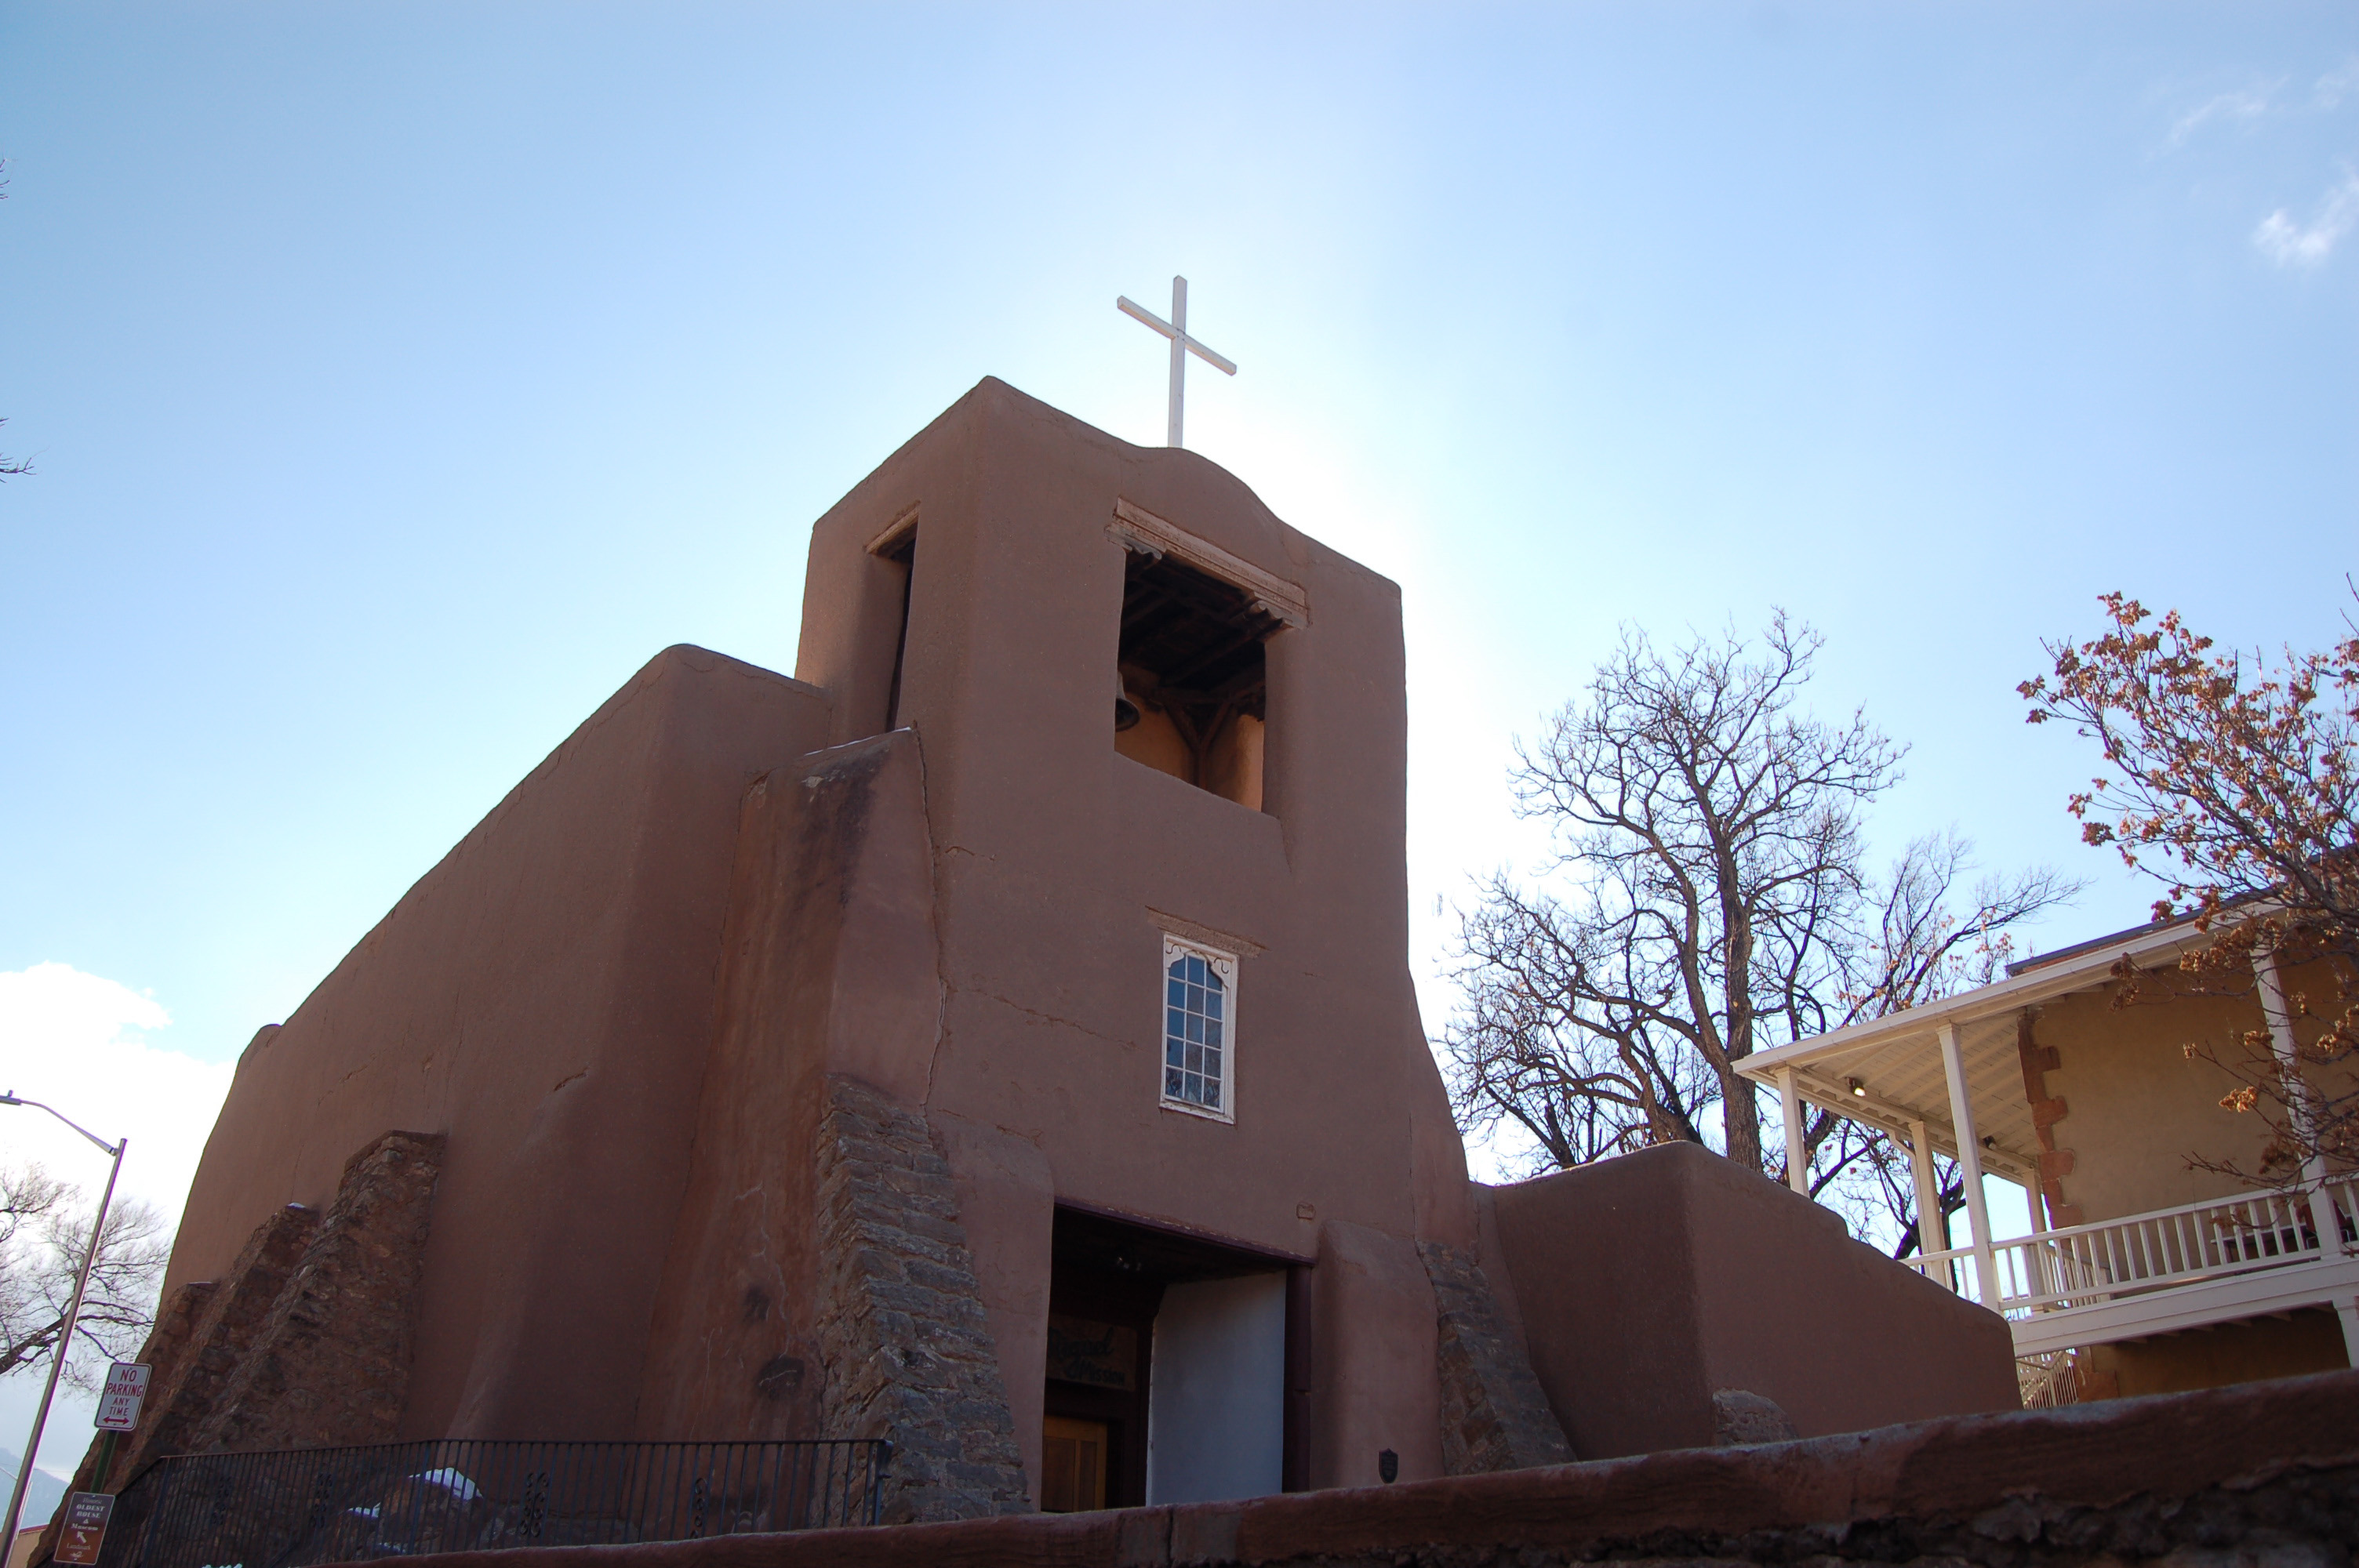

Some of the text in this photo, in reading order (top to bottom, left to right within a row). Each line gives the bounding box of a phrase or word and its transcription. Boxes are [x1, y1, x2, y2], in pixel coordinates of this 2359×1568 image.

[120, 1369, 137, 1382] NO
[106, 1382, 143, 1397] PARKING
[112, 1397, 130, 1406] ANY
[109, 1406, 129, 1416] TIME
